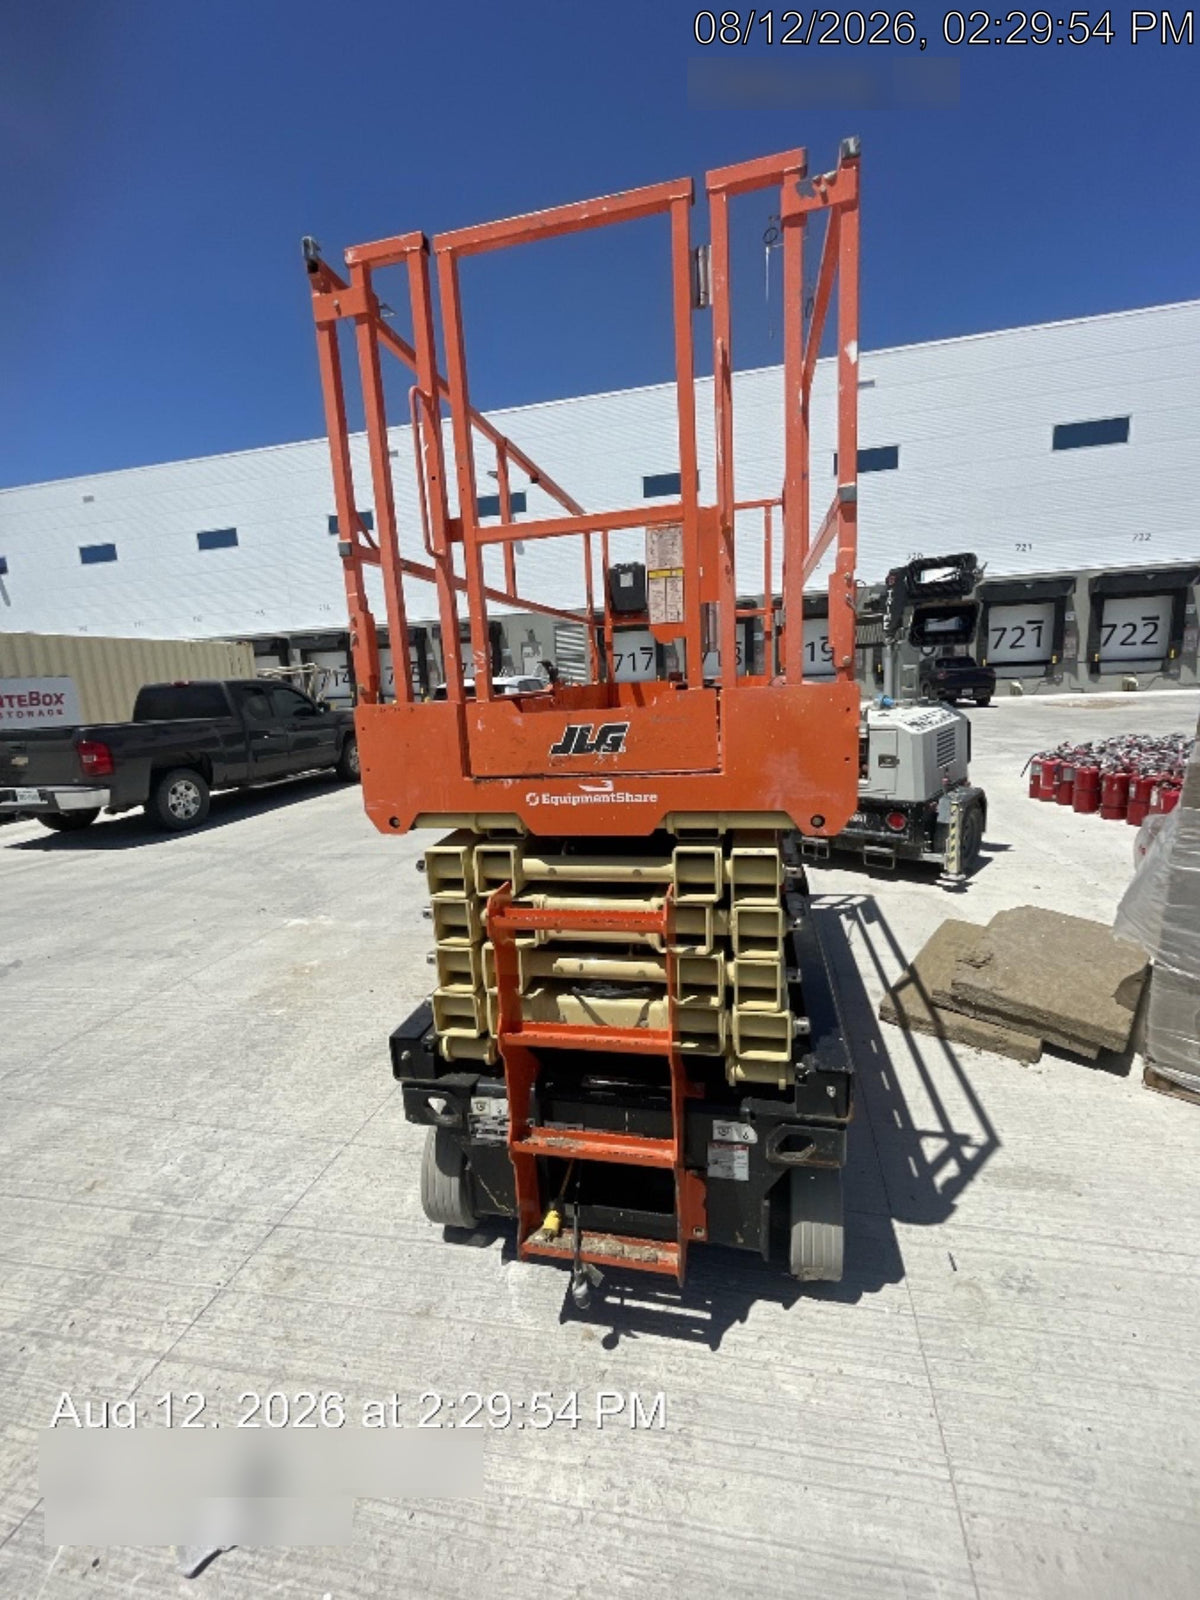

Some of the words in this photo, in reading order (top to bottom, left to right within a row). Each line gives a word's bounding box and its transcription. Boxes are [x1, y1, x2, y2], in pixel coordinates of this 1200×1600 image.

[990, 624, 1042, 650] 721
[1100, 622, 1159, 648] 722
[613, 651, 653, 673] 717
[549, 722, 630, 756] JLG
[541, 791, 658, 806] EquipmentShare
